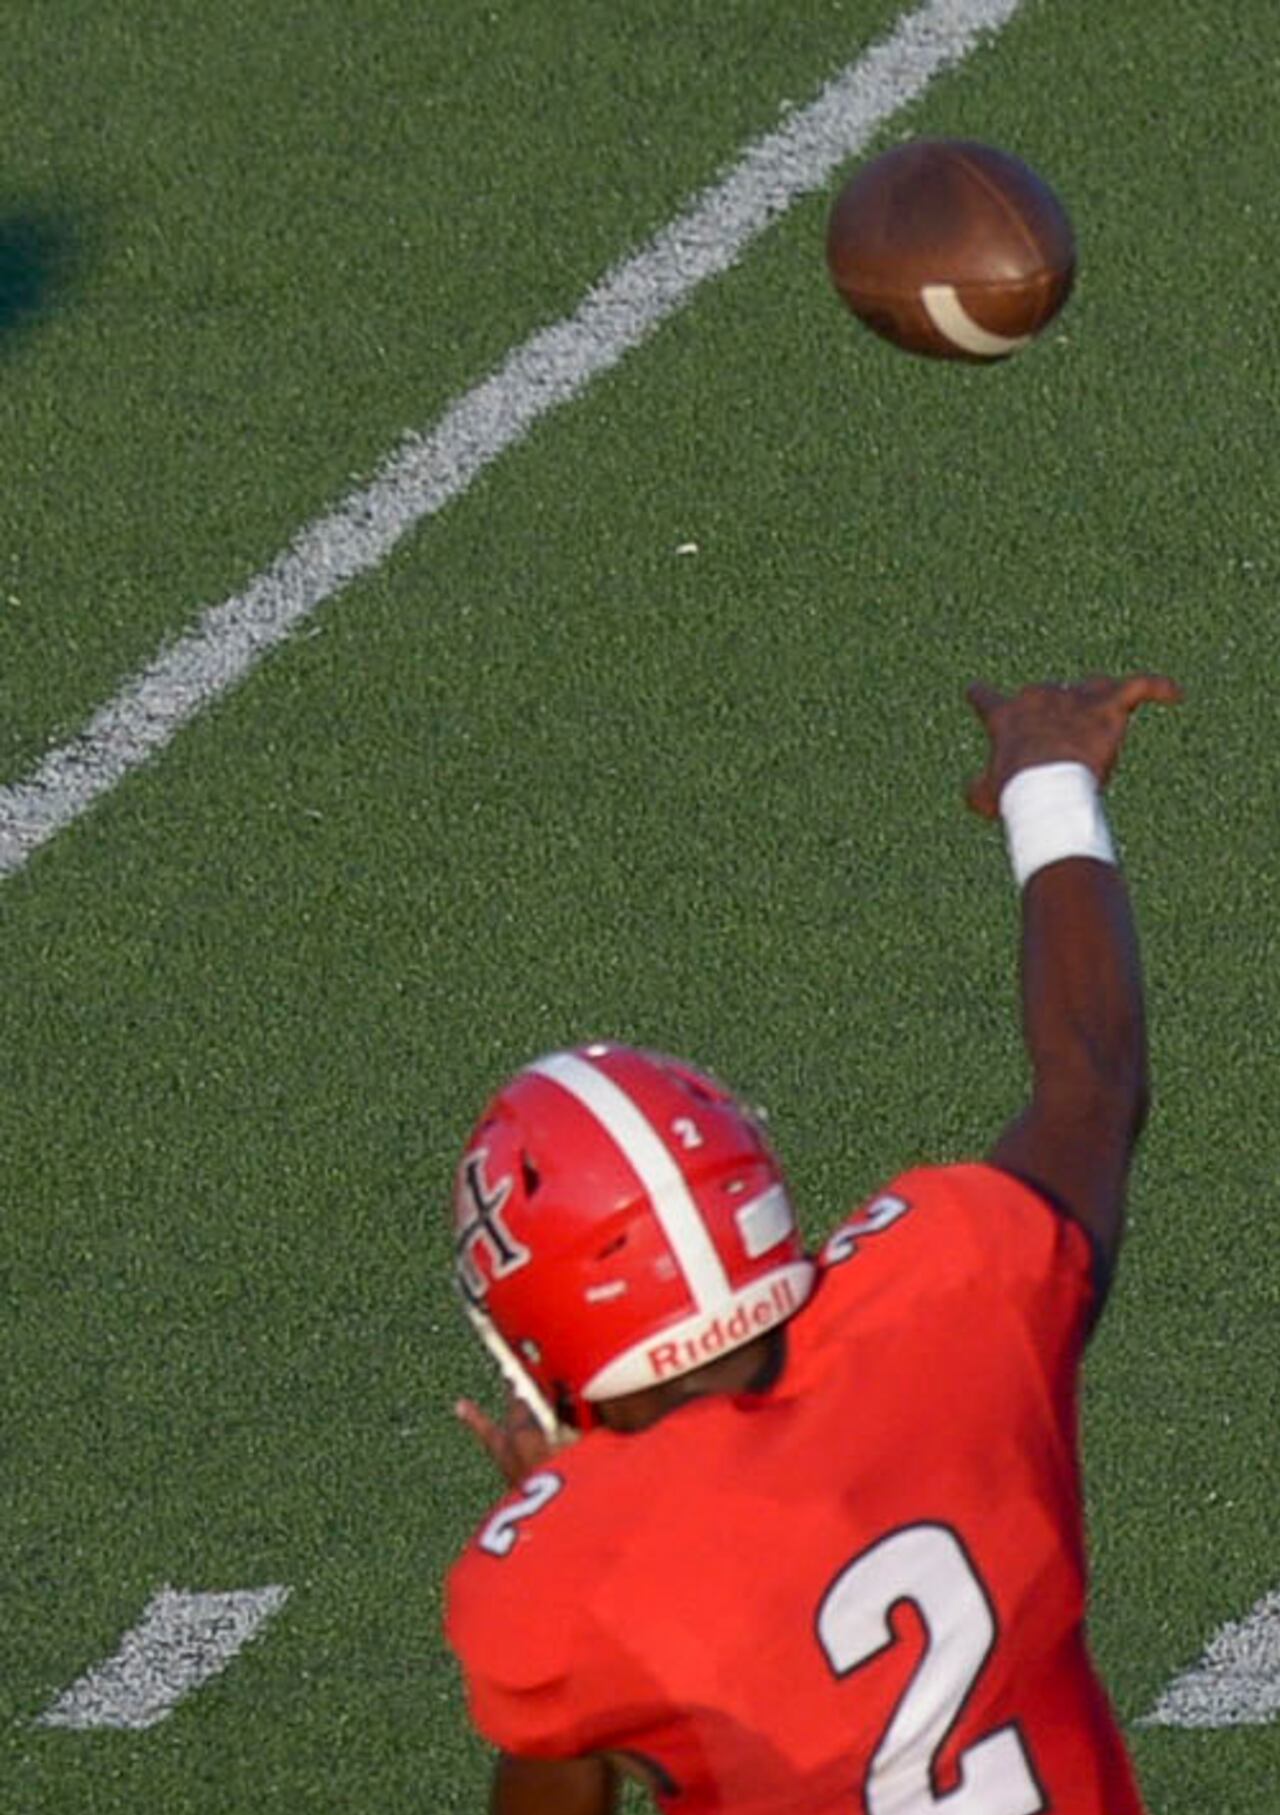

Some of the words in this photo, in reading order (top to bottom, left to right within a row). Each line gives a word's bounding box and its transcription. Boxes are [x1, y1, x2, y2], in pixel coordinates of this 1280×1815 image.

[672, 1117, 703, 1148] 2
[821, 1194, 909, 1267] 2
[648, 1278, 794, 1377] Riddell
[479, 1470, 565, 1556] 2
